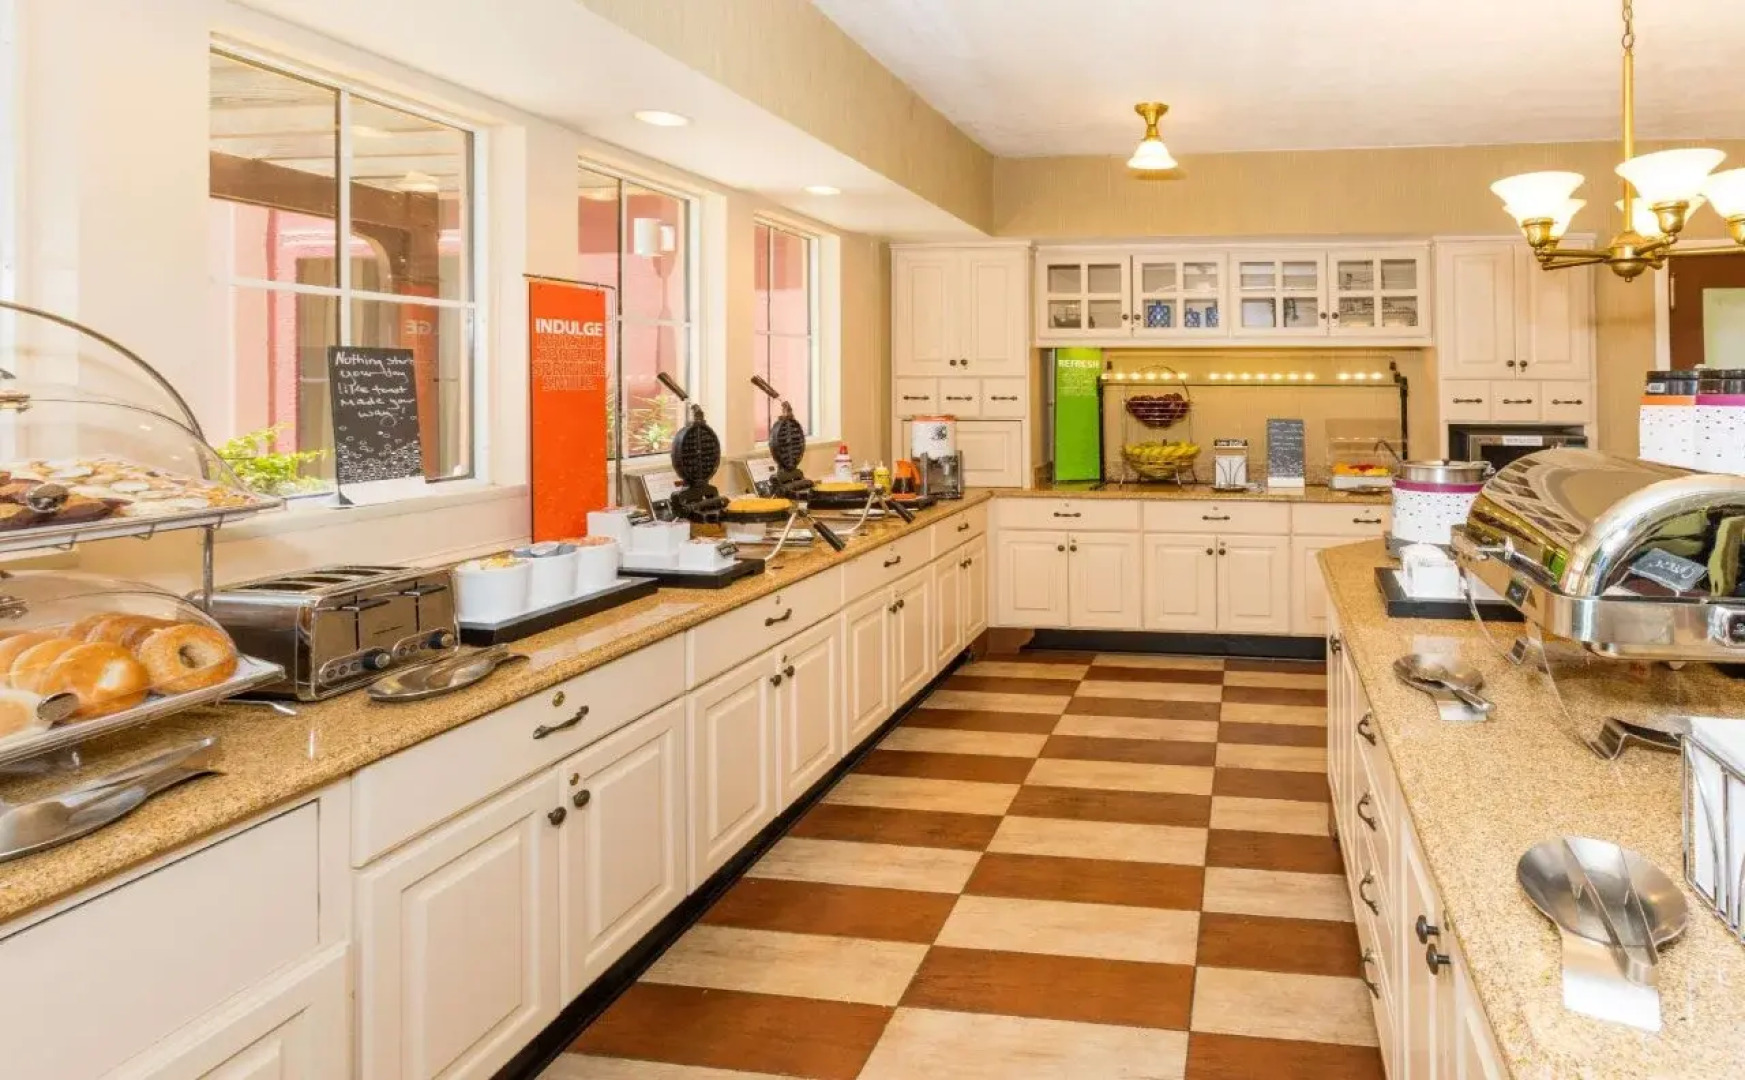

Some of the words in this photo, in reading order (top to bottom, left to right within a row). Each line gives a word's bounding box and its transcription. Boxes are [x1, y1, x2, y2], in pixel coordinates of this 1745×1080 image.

[535, 318, 604, 336] INDULGE
[335, 351, 385, 372] Nothing
[1058, 360, 1100, 368] REFRESH
